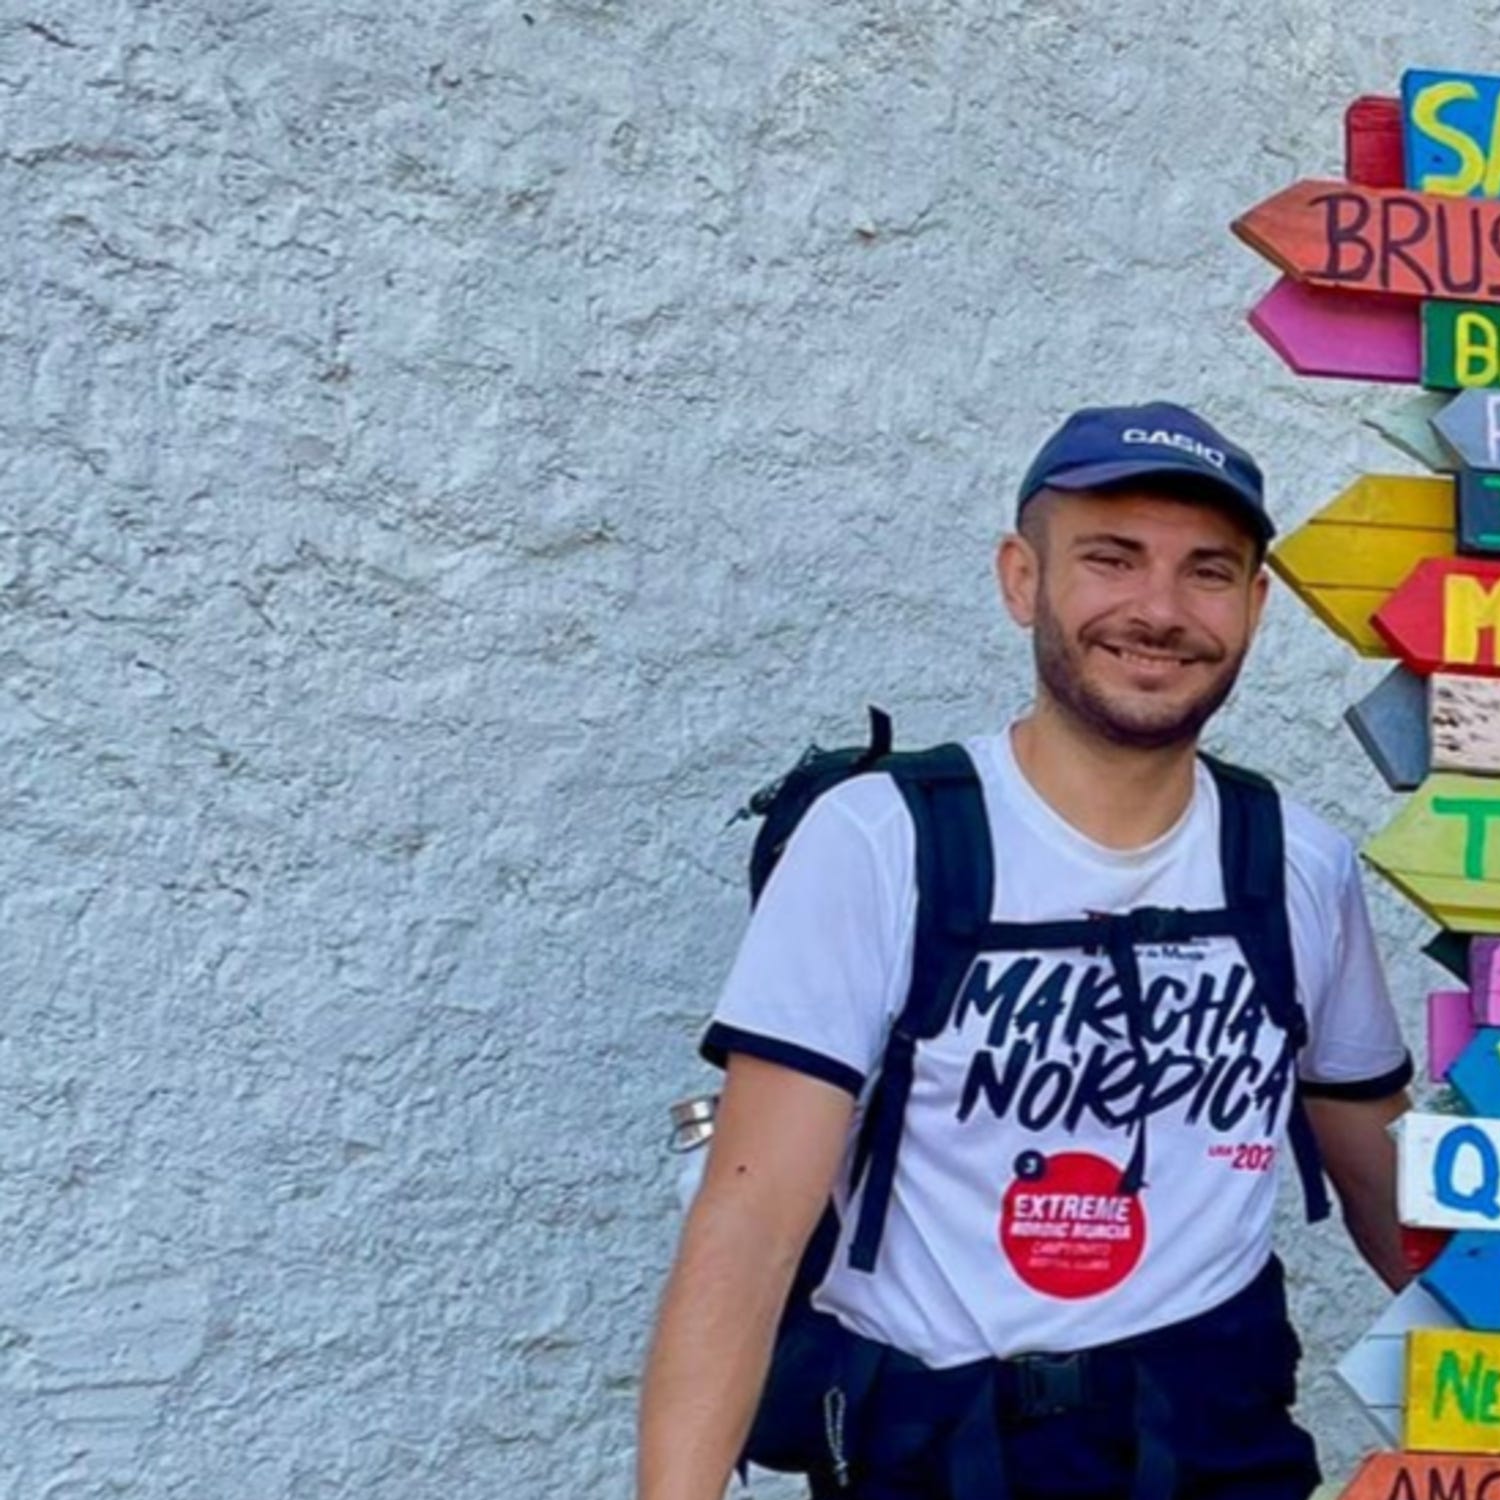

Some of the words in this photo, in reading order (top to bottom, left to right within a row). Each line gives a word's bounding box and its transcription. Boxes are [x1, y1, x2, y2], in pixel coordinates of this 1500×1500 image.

[1122, 428, 1226, 468] CASIO
[954, 958, 1266, 1058] MARCHA
[1014, 1194, 1131, 1223] EXTREME
